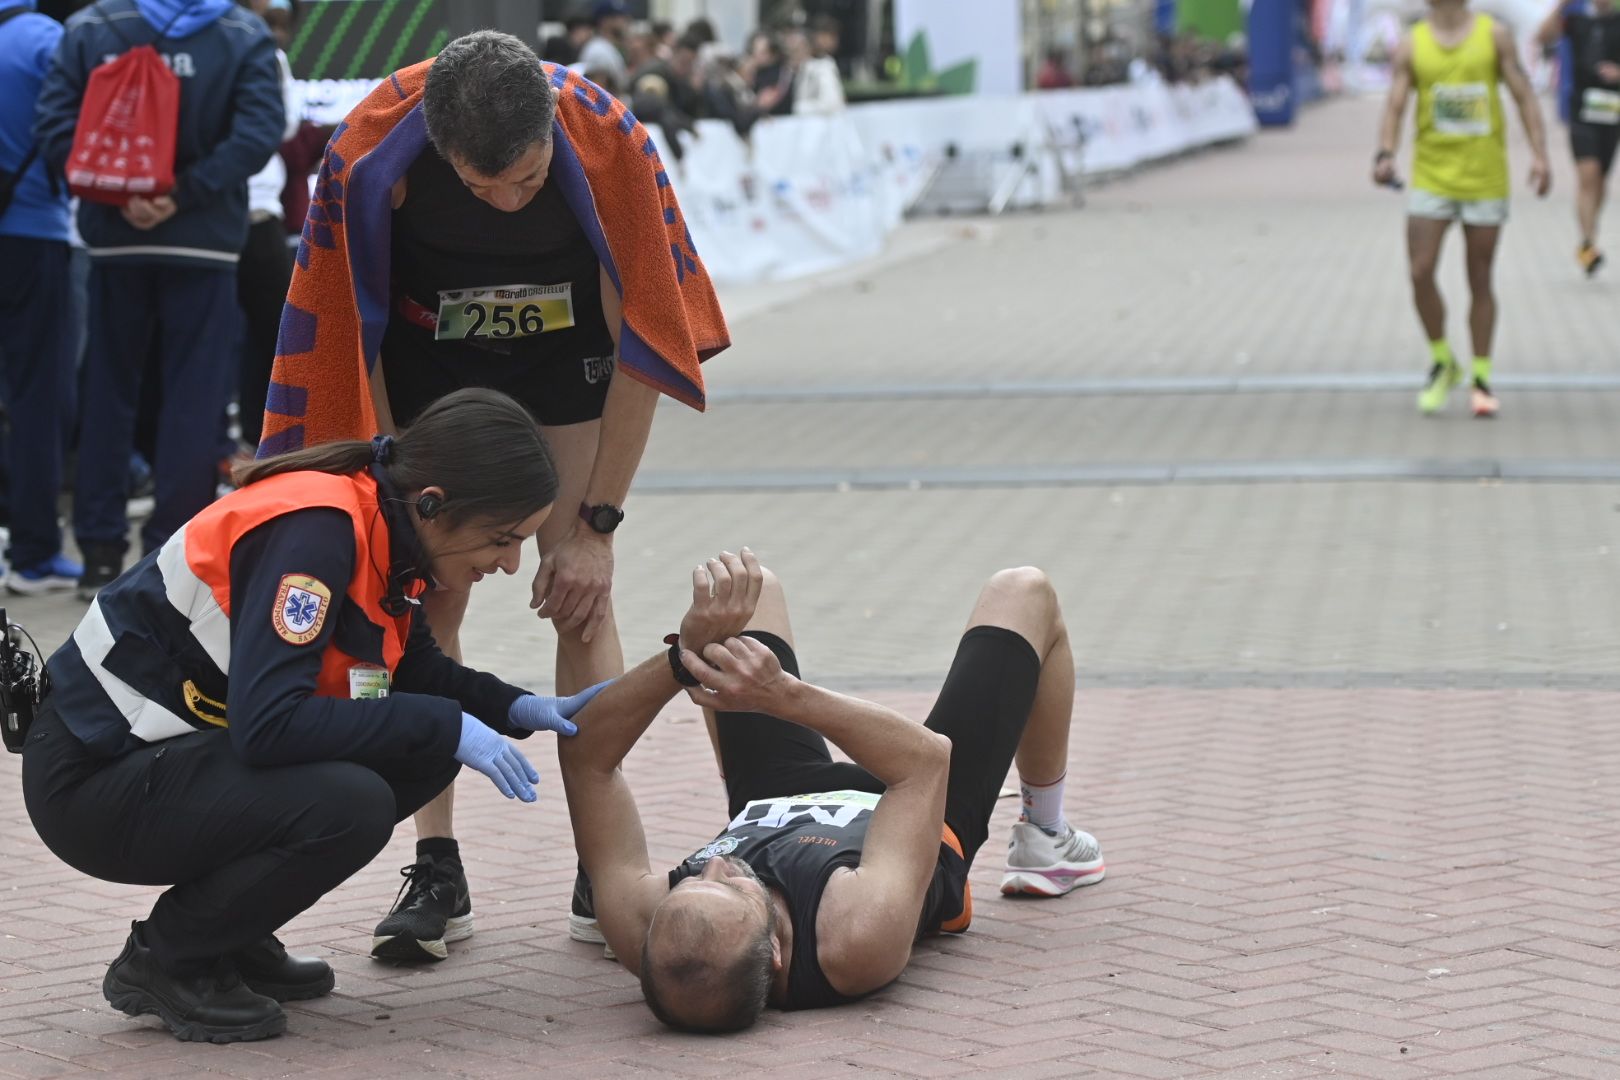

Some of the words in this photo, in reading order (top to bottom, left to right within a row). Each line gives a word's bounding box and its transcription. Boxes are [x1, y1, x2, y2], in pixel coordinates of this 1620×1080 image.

[463, 302, 544, 338] 256
[274, 583, 288, 636] TRANSPORTE
[298, 597, 329, 642] SANITARIO
